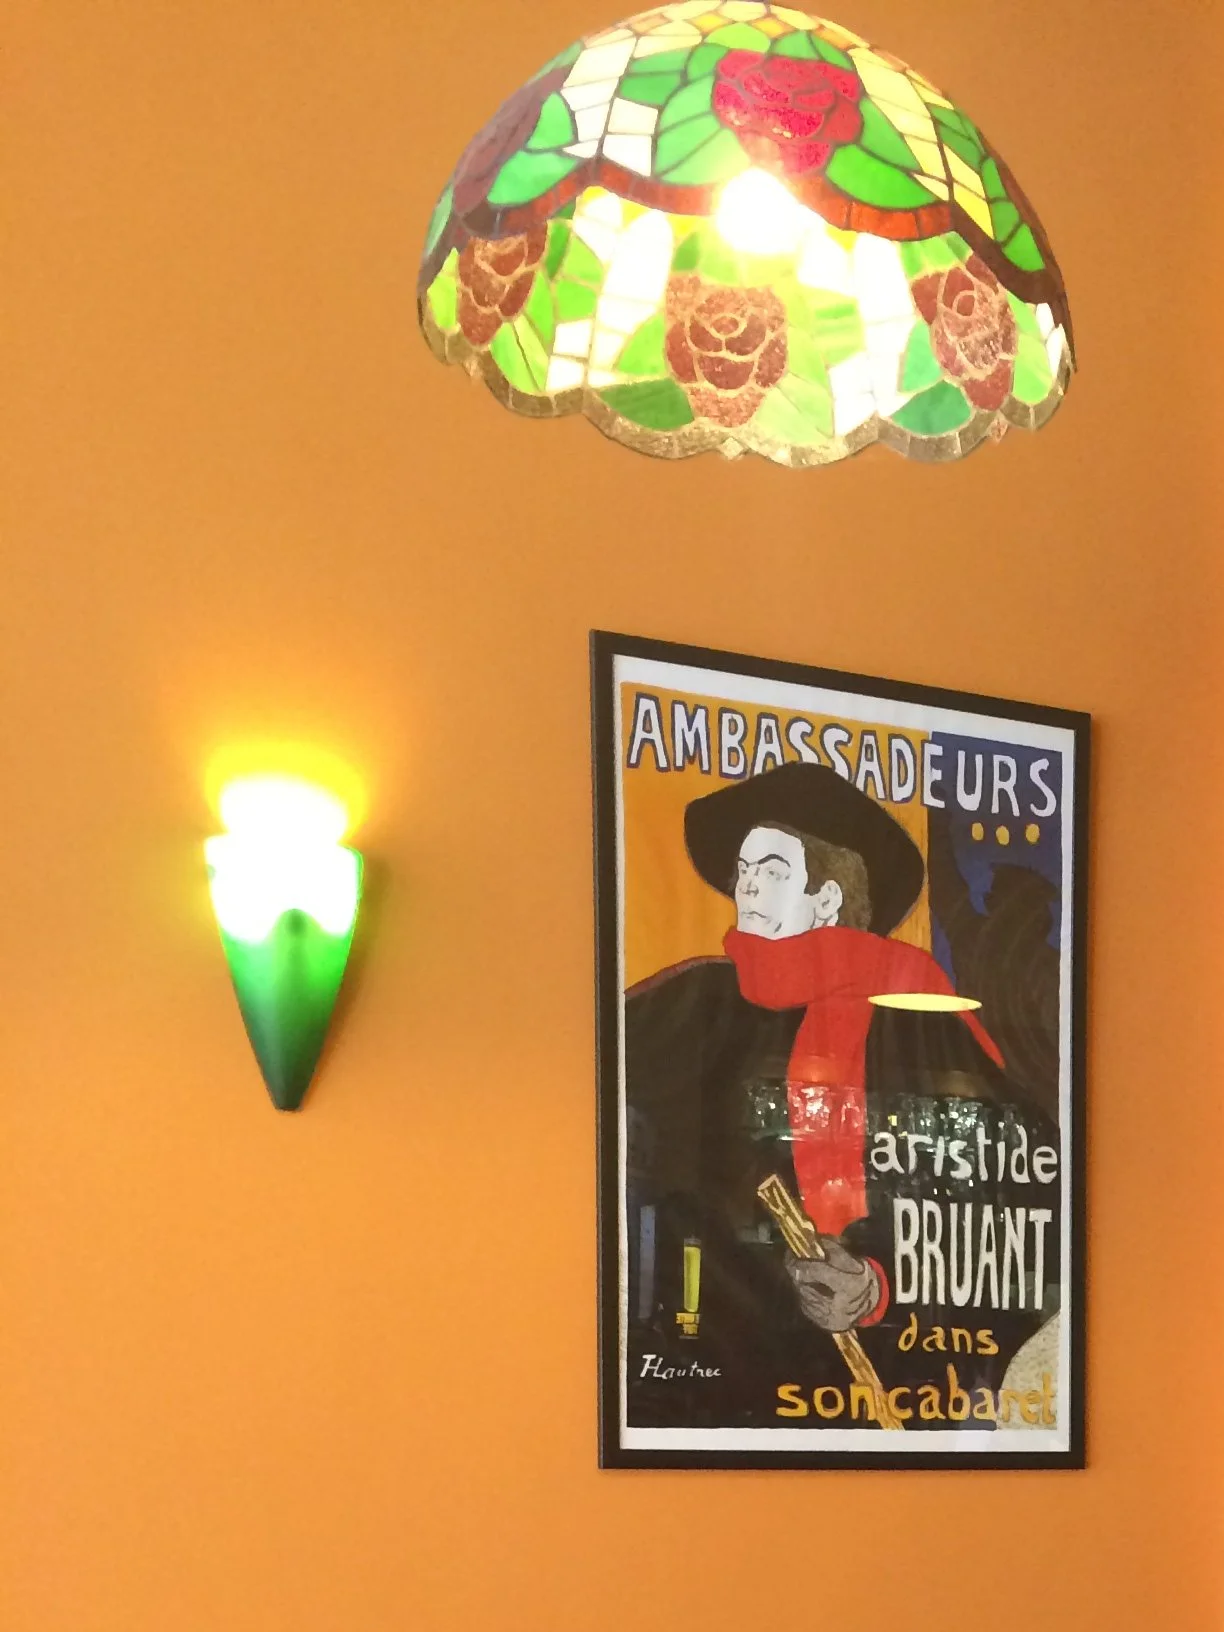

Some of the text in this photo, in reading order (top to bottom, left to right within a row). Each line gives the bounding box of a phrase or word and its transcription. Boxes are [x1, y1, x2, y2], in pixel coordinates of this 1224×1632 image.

[627, 692, 1057, 818] AMBASSADEURS
[870, 1124, 1058, 1184] aristide
[893, 1198, 1053, 1311] BRUANT
[898, 1312, 999, 1355] dans
[775, 1362, 1058, 1425] son cabaret
